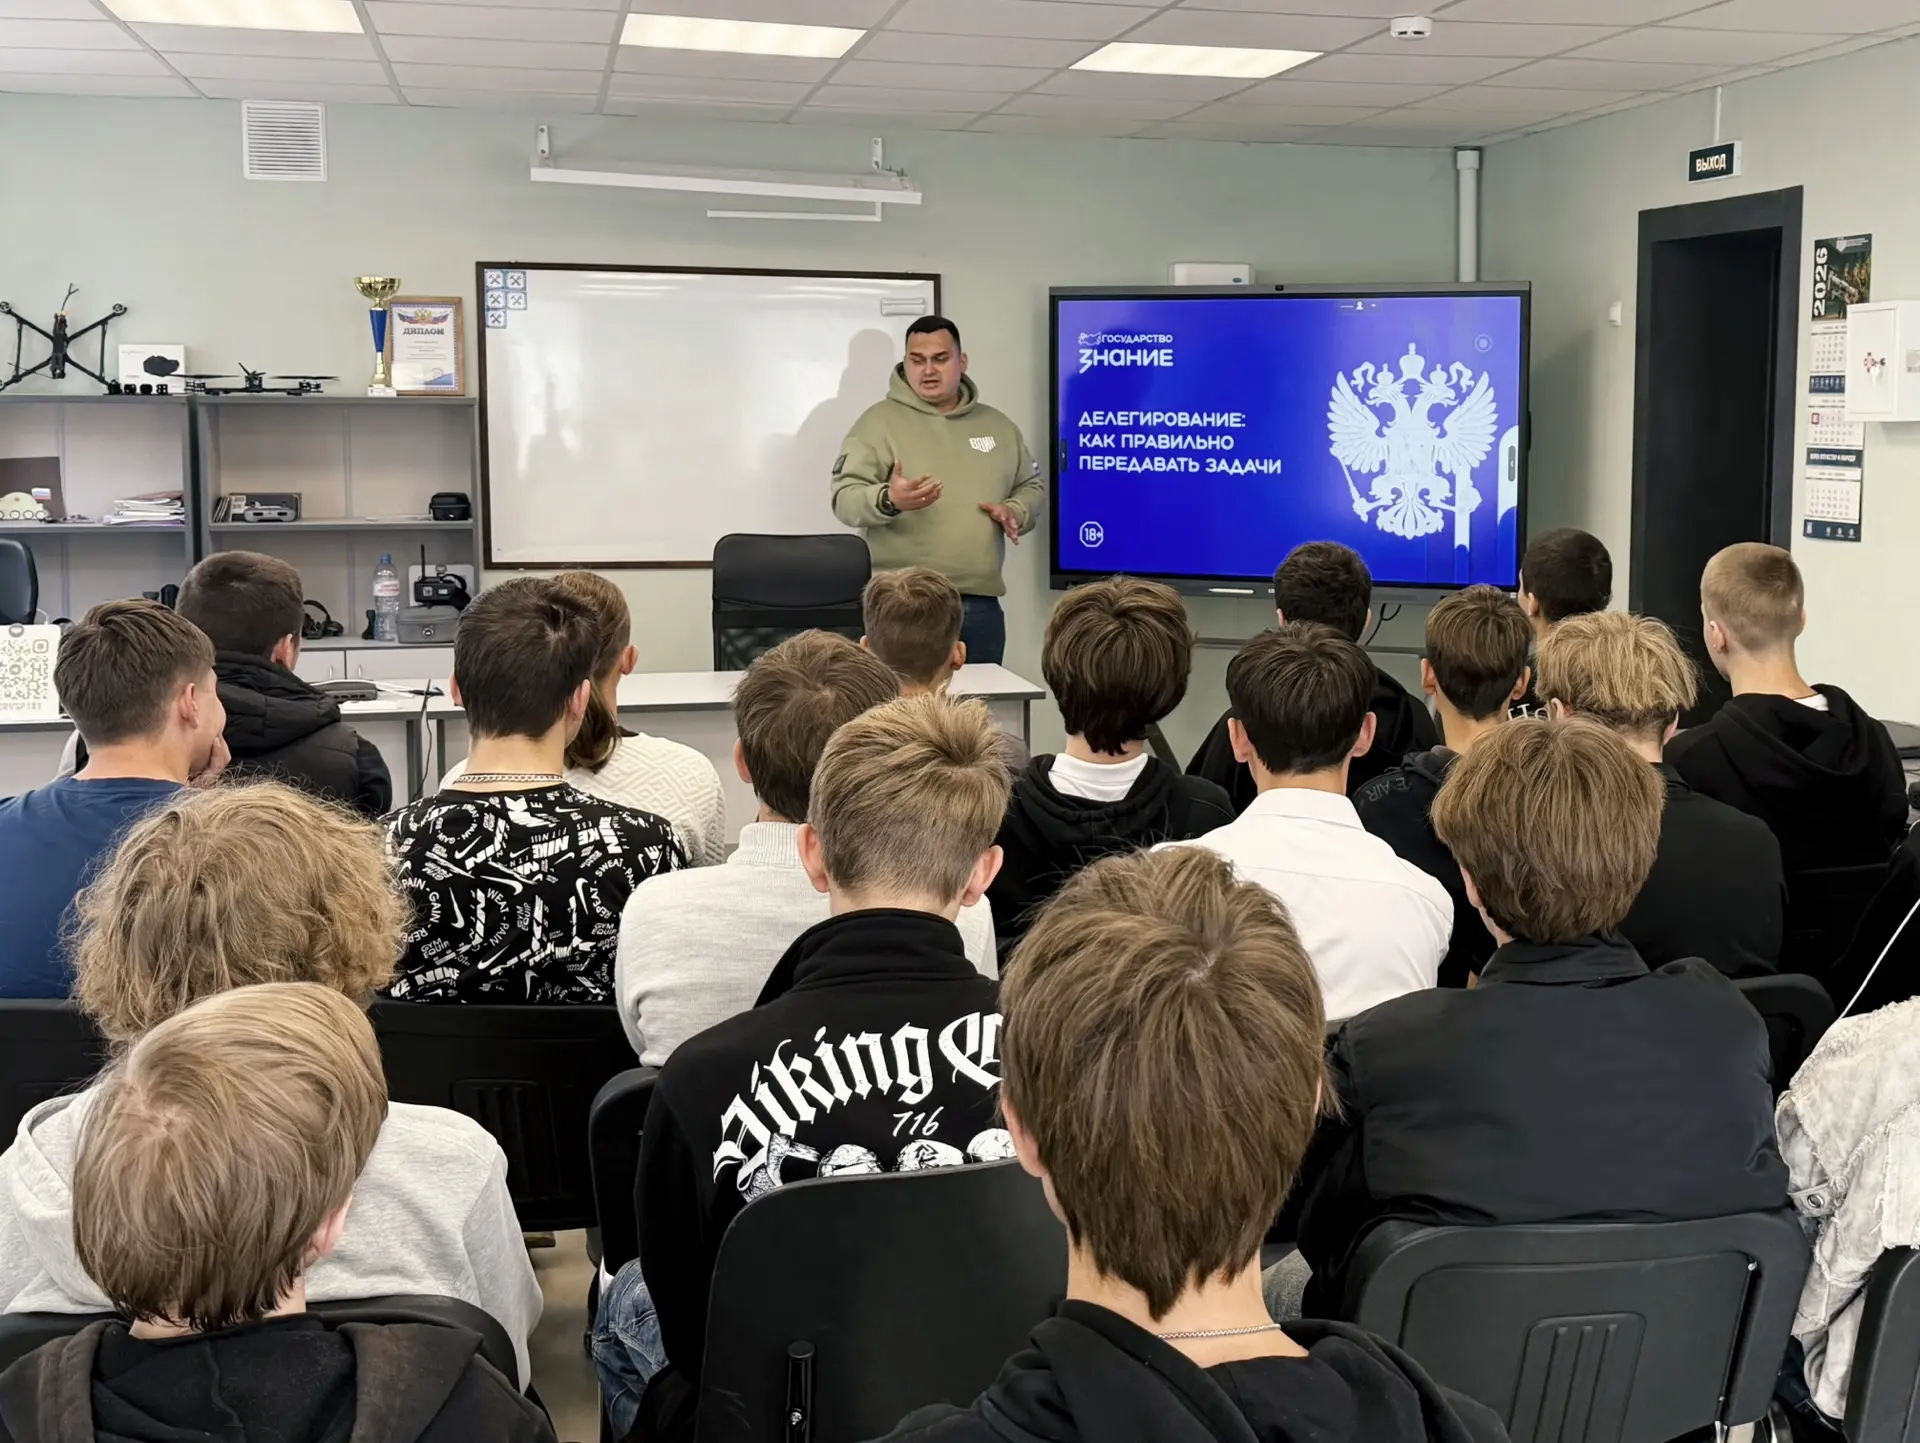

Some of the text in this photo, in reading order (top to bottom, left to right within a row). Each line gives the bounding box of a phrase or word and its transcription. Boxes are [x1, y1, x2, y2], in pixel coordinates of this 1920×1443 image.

[1695, 153, 1727, 173] ВЫХОД
[1813, 247, 1828, 316] 2026
[402, 327, 445, 335] ДИПЛОМ
[1101, 334, 1174, 344] ГОСУДАРСТВО
[1078, 348, 1174, 374] ЗНАНИЕ
[1078, 411, 1246, 428] ДЕЛЕГИРОВАНИЕ:
[1079, 433, 1235, 450] КАК ПРАВИЛЬНО
[1079, 455, 1282, 476] ПЕРЕДАВАТЬ ЗАДАЧИ
[1084, 527, 1103, 541] 18+
[1365, 780, 1390, 802] AIR
[531, 835, 570, 859] NIKE
[594, 858, 624, 878] SWEAT
[401, 878, 426, 890] PAIN
[428, 891, 442, 923] GAIN
[589, 886, 612, 919] REPEAT
[489, 922, 510, 947] PAIN
[594, 922, 615, 930] GYM
[414, 966, 460, 986] NIKE
[892, 1106, 944, 1137] 716
